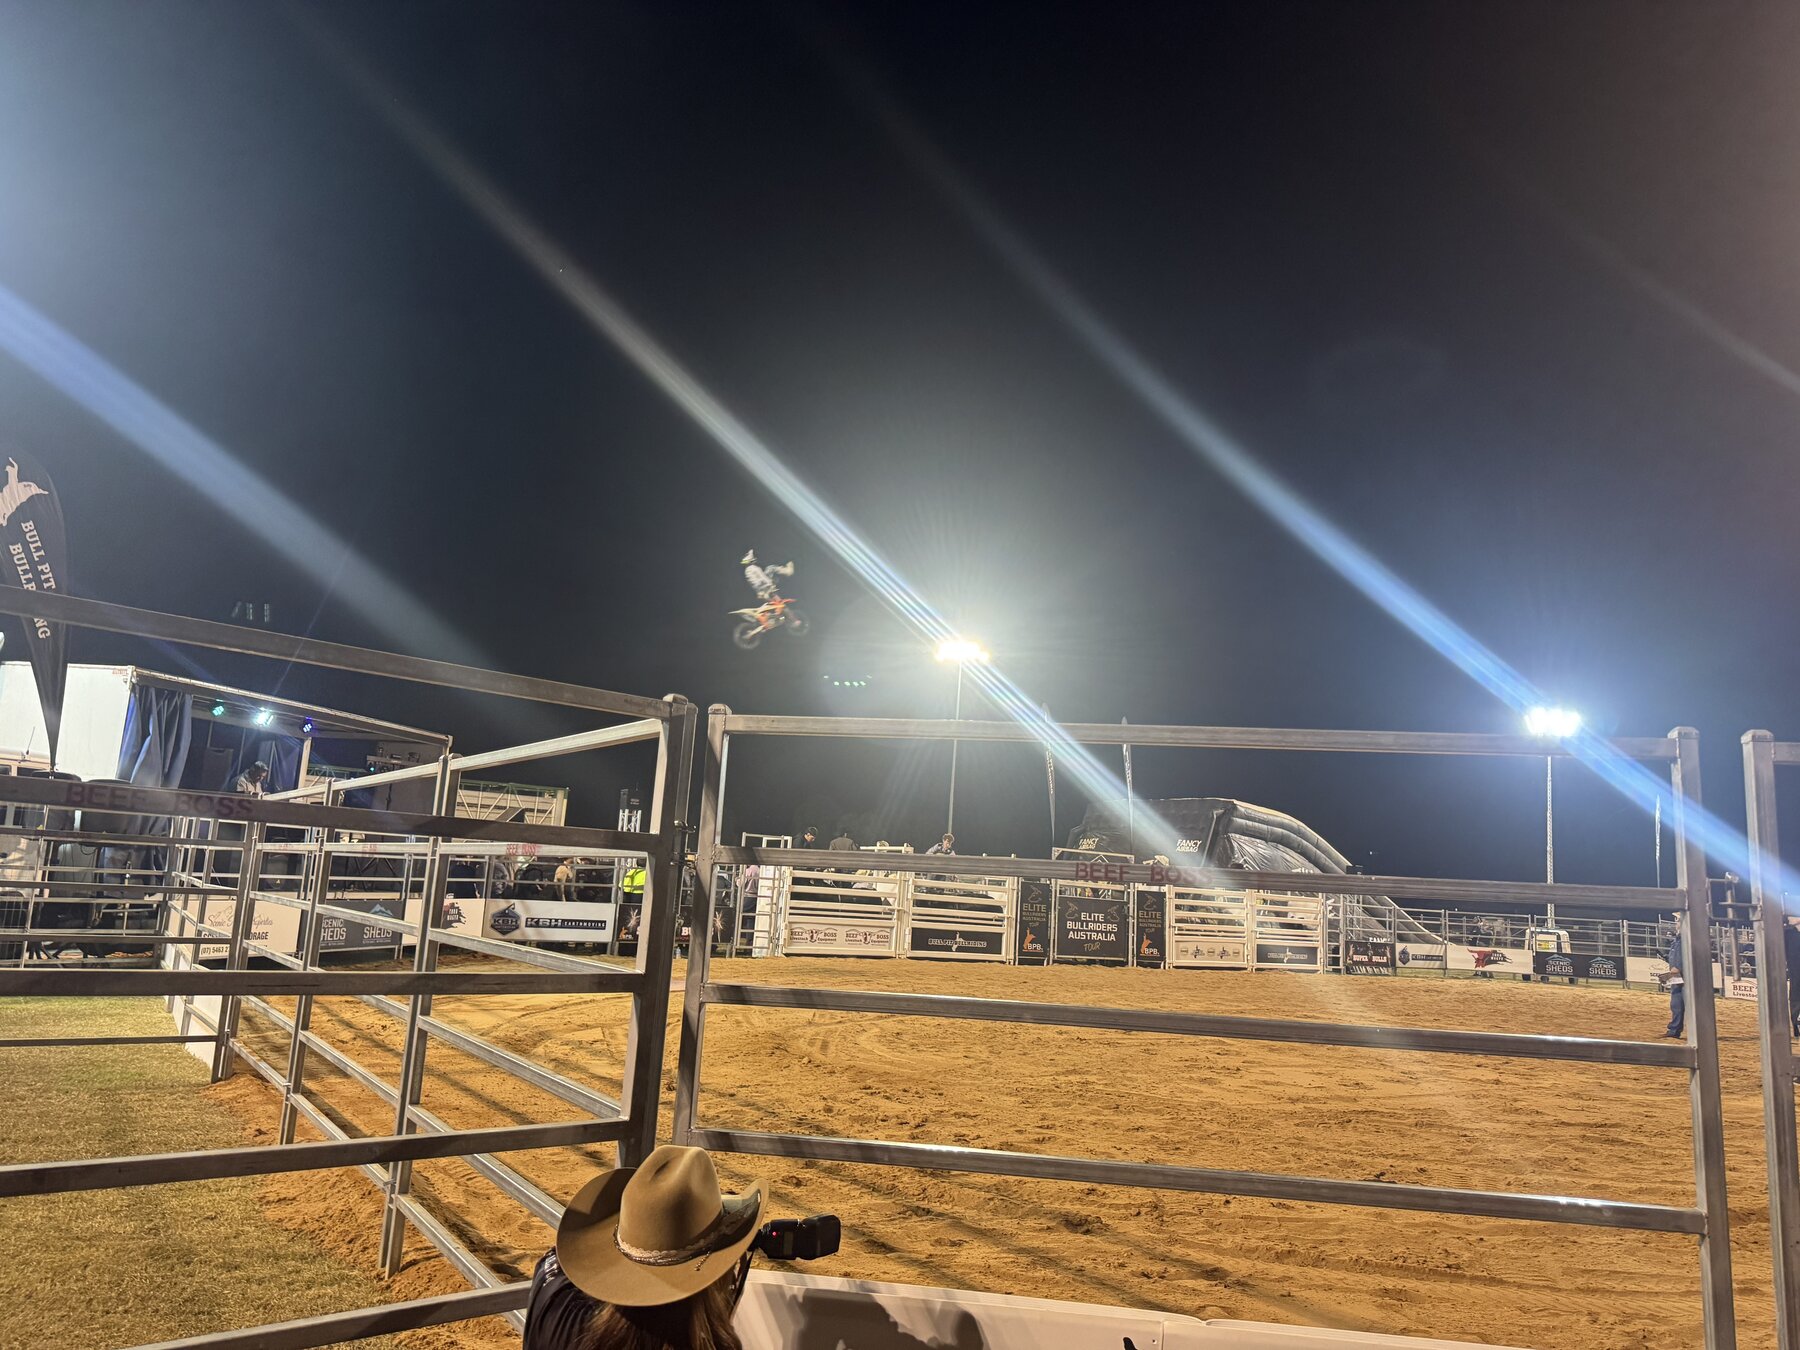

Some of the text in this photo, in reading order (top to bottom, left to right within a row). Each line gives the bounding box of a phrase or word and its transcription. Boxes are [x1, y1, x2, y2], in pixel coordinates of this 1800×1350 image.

[21, 520, 56, 589] BULL PIT
[66, 784, 254, 816] BEEF BOSS
[1177, 839, 1202, 847] FANCY
[1075, 862, 1213, 884] BEEF BOSS
[1023, 903, 1047, 912] ELITE
[1081, 912, 1105, 921] ELITE
[1138, 910, 1162, 919] ELITE
[526, 918, 562, 927] KBH
[1066, 920, 1118, 932] BULLRIDERS
[321, 927, 347, 941] HEDS
[1068, 930, 1116, 941] AUSTRALIA
[1083, 941, 1101, 951] TOUR
[1545, 965, 1574, 973] SHEDS
[1589, 967, 1617, 976] SHEDS
[1732, 984, 1755, 993] BEEF
